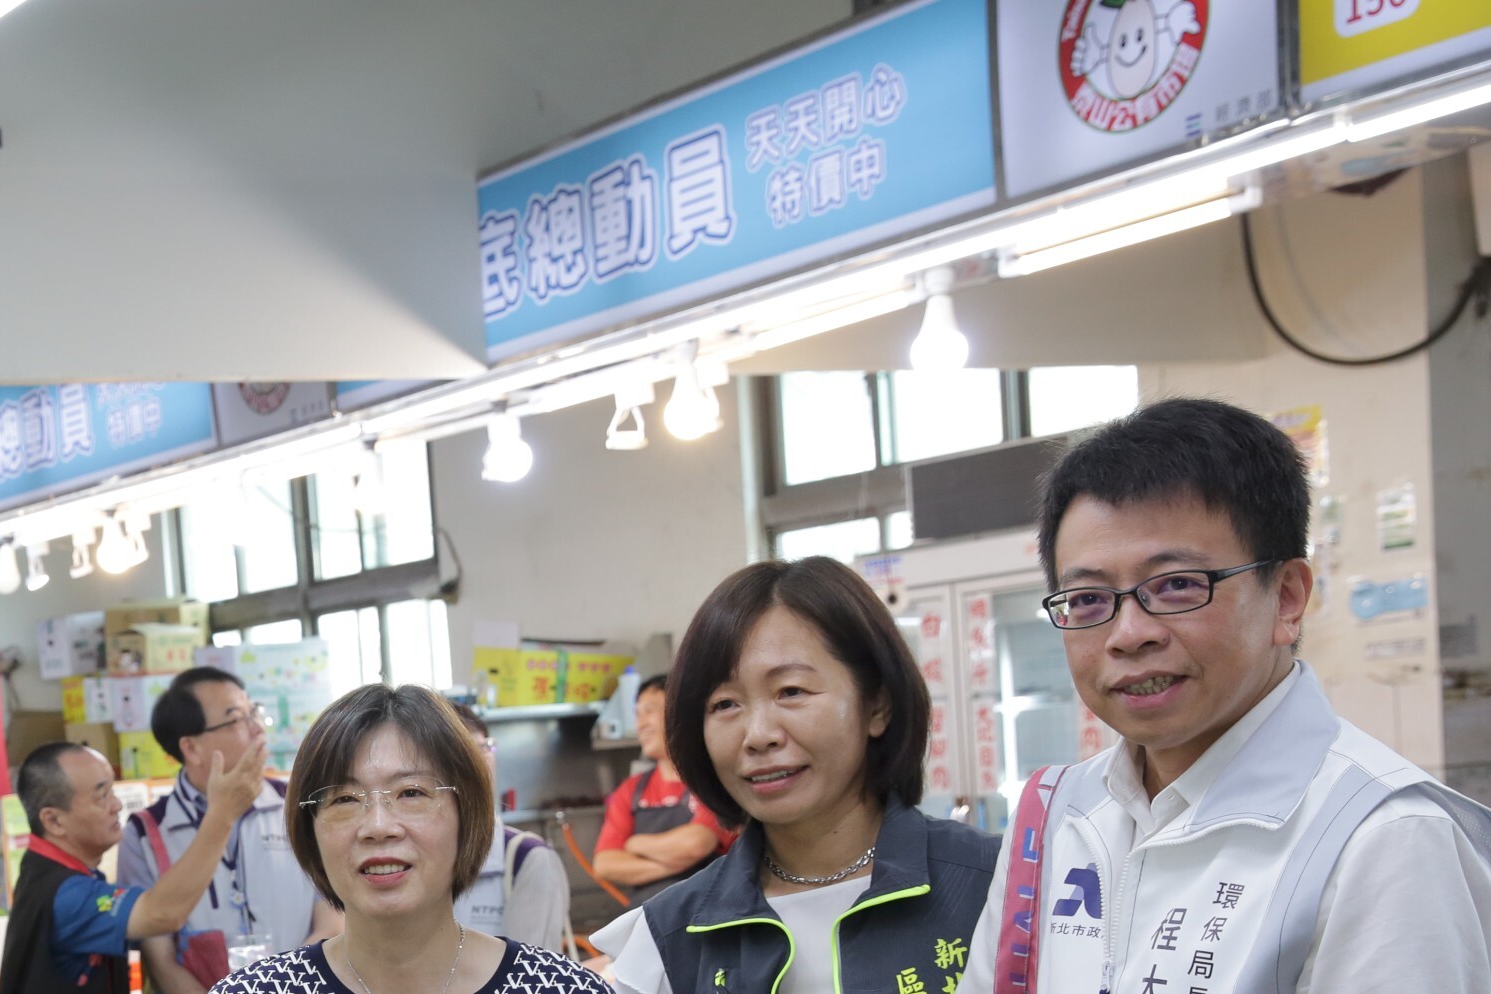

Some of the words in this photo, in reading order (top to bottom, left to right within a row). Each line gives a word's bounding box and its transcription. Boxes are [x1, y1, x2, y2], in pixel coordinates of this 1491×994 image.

[746, 66, 907, 170] 天天開心
[478, 127, 734, 320] 底總動員
[767, 138, 886, 227] 特價中
[1050, 922, 1106, 939] 北市政
